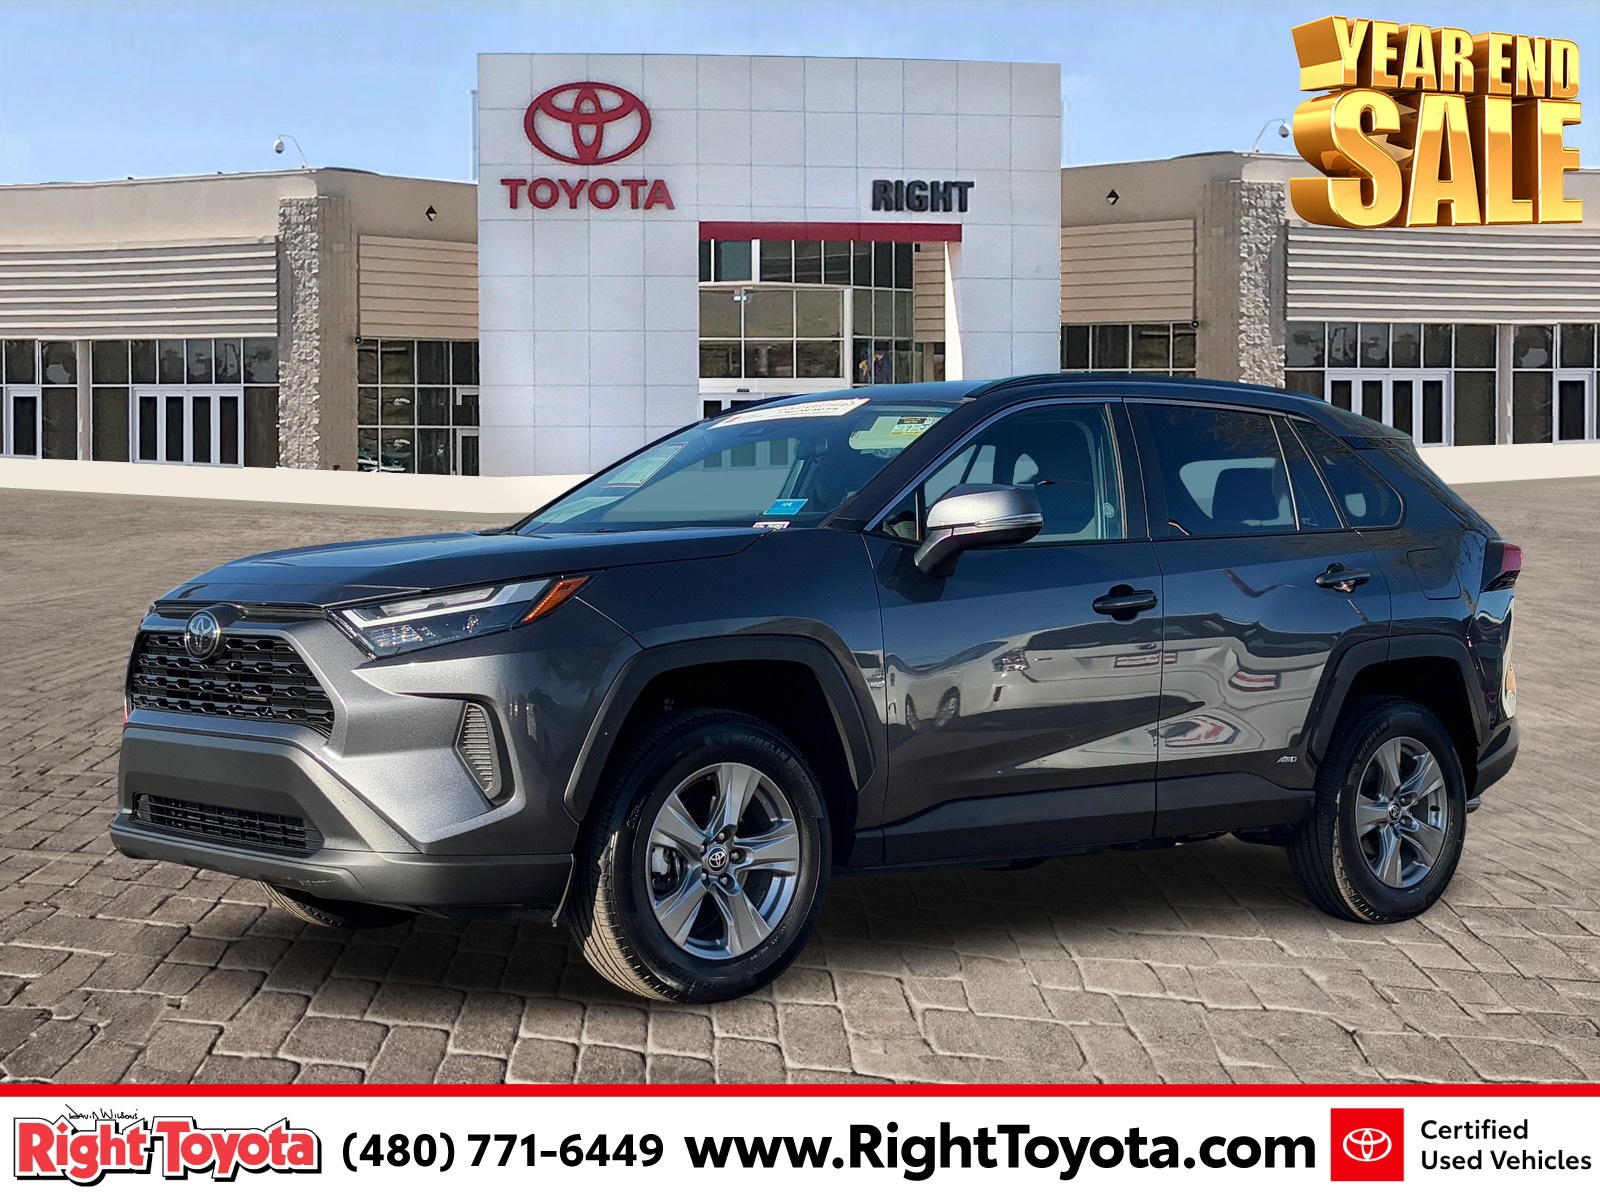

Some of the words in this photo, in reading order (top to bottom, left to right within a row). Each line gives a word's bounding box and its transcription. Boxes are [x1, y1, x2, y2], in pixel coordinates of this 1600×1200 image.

[500, 178, 676, 210] TOYOTA
[871, 179, 976, 213] RIGHT
[731, 733, 791, 763] MICHELIN
